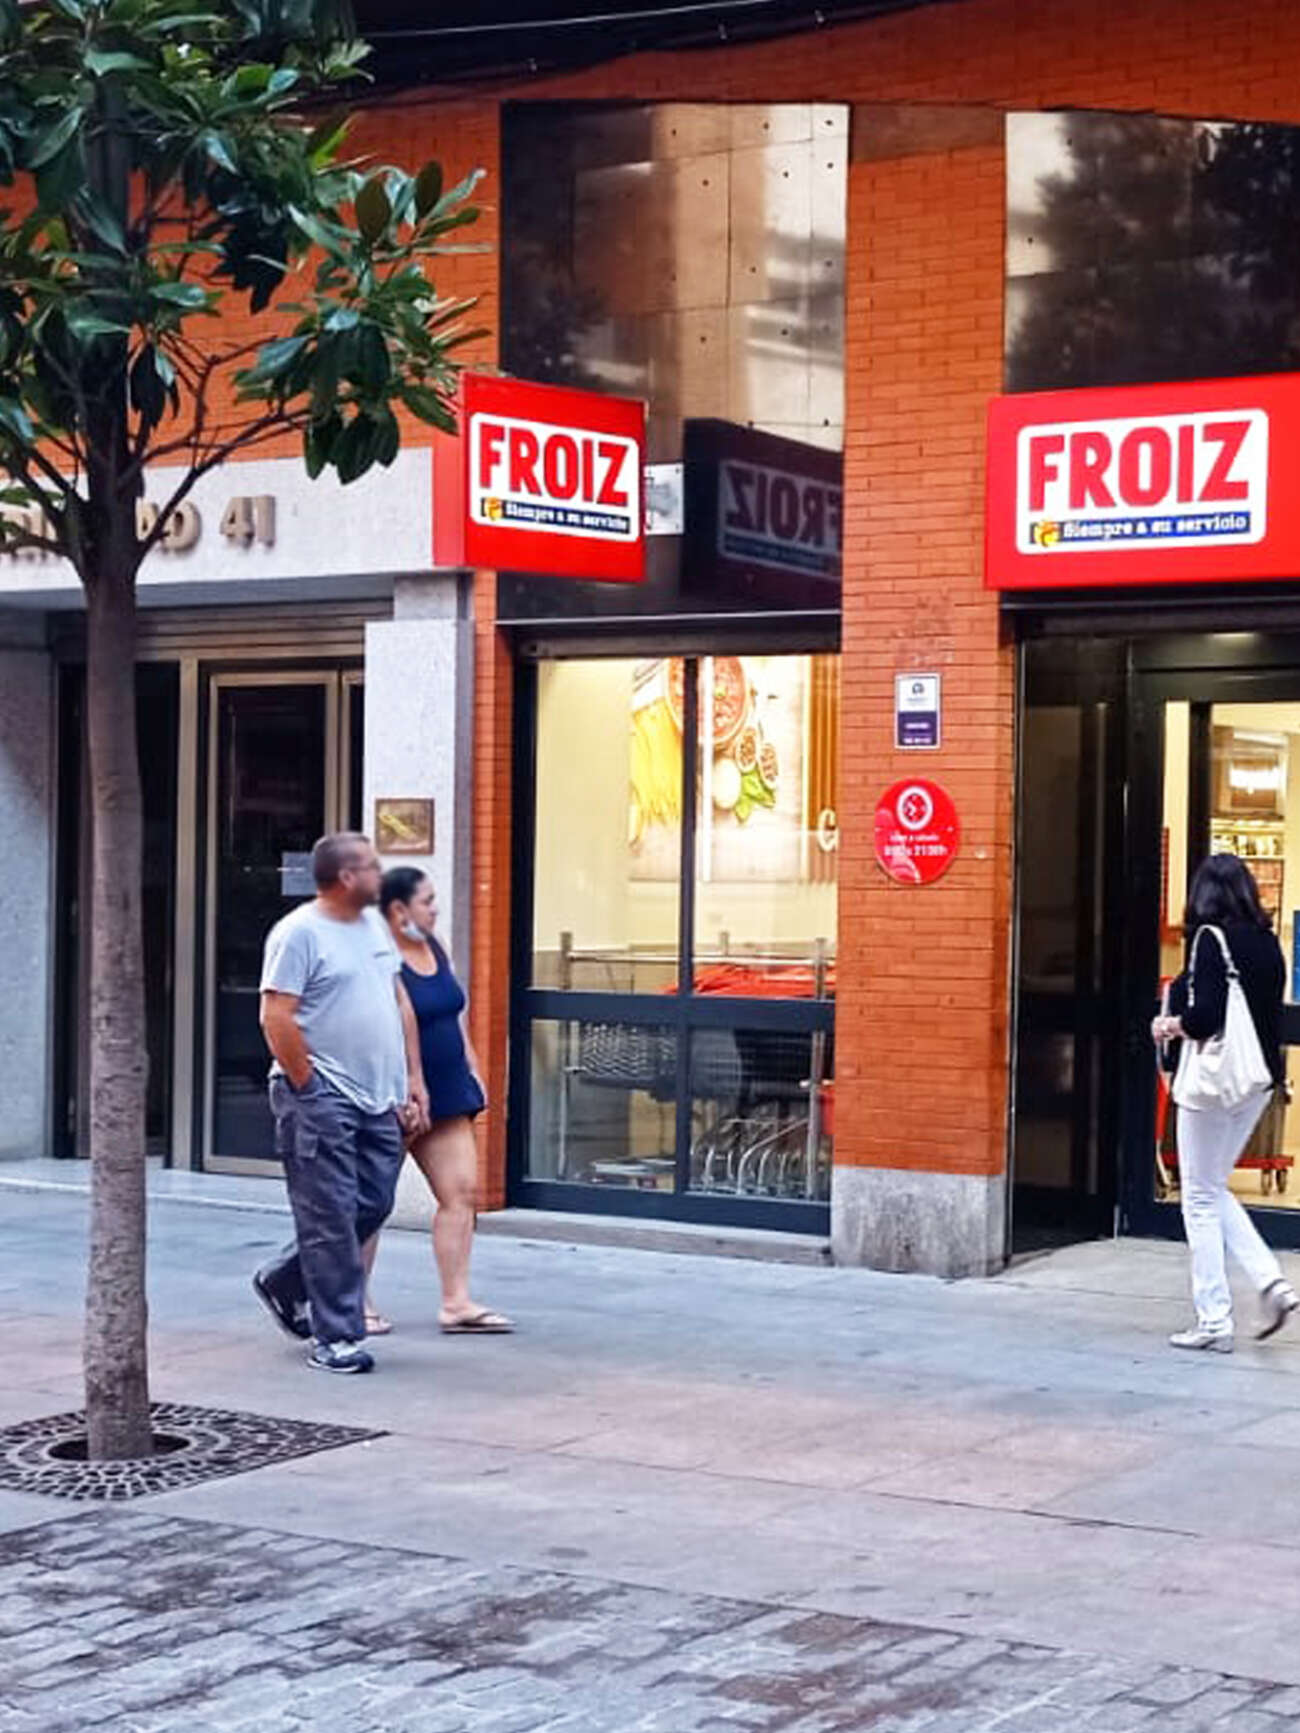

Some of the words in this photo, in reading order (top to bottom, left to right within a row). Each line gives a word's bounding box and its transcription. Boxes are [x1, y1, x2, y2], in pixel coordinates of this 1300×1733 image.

[479, 422, 629, 507] FROIZ
[1029, 420, 1252, 511] FROIZ
[219, 495, 276, 548] 41
[1176, 514, 1247, 532] servicio
